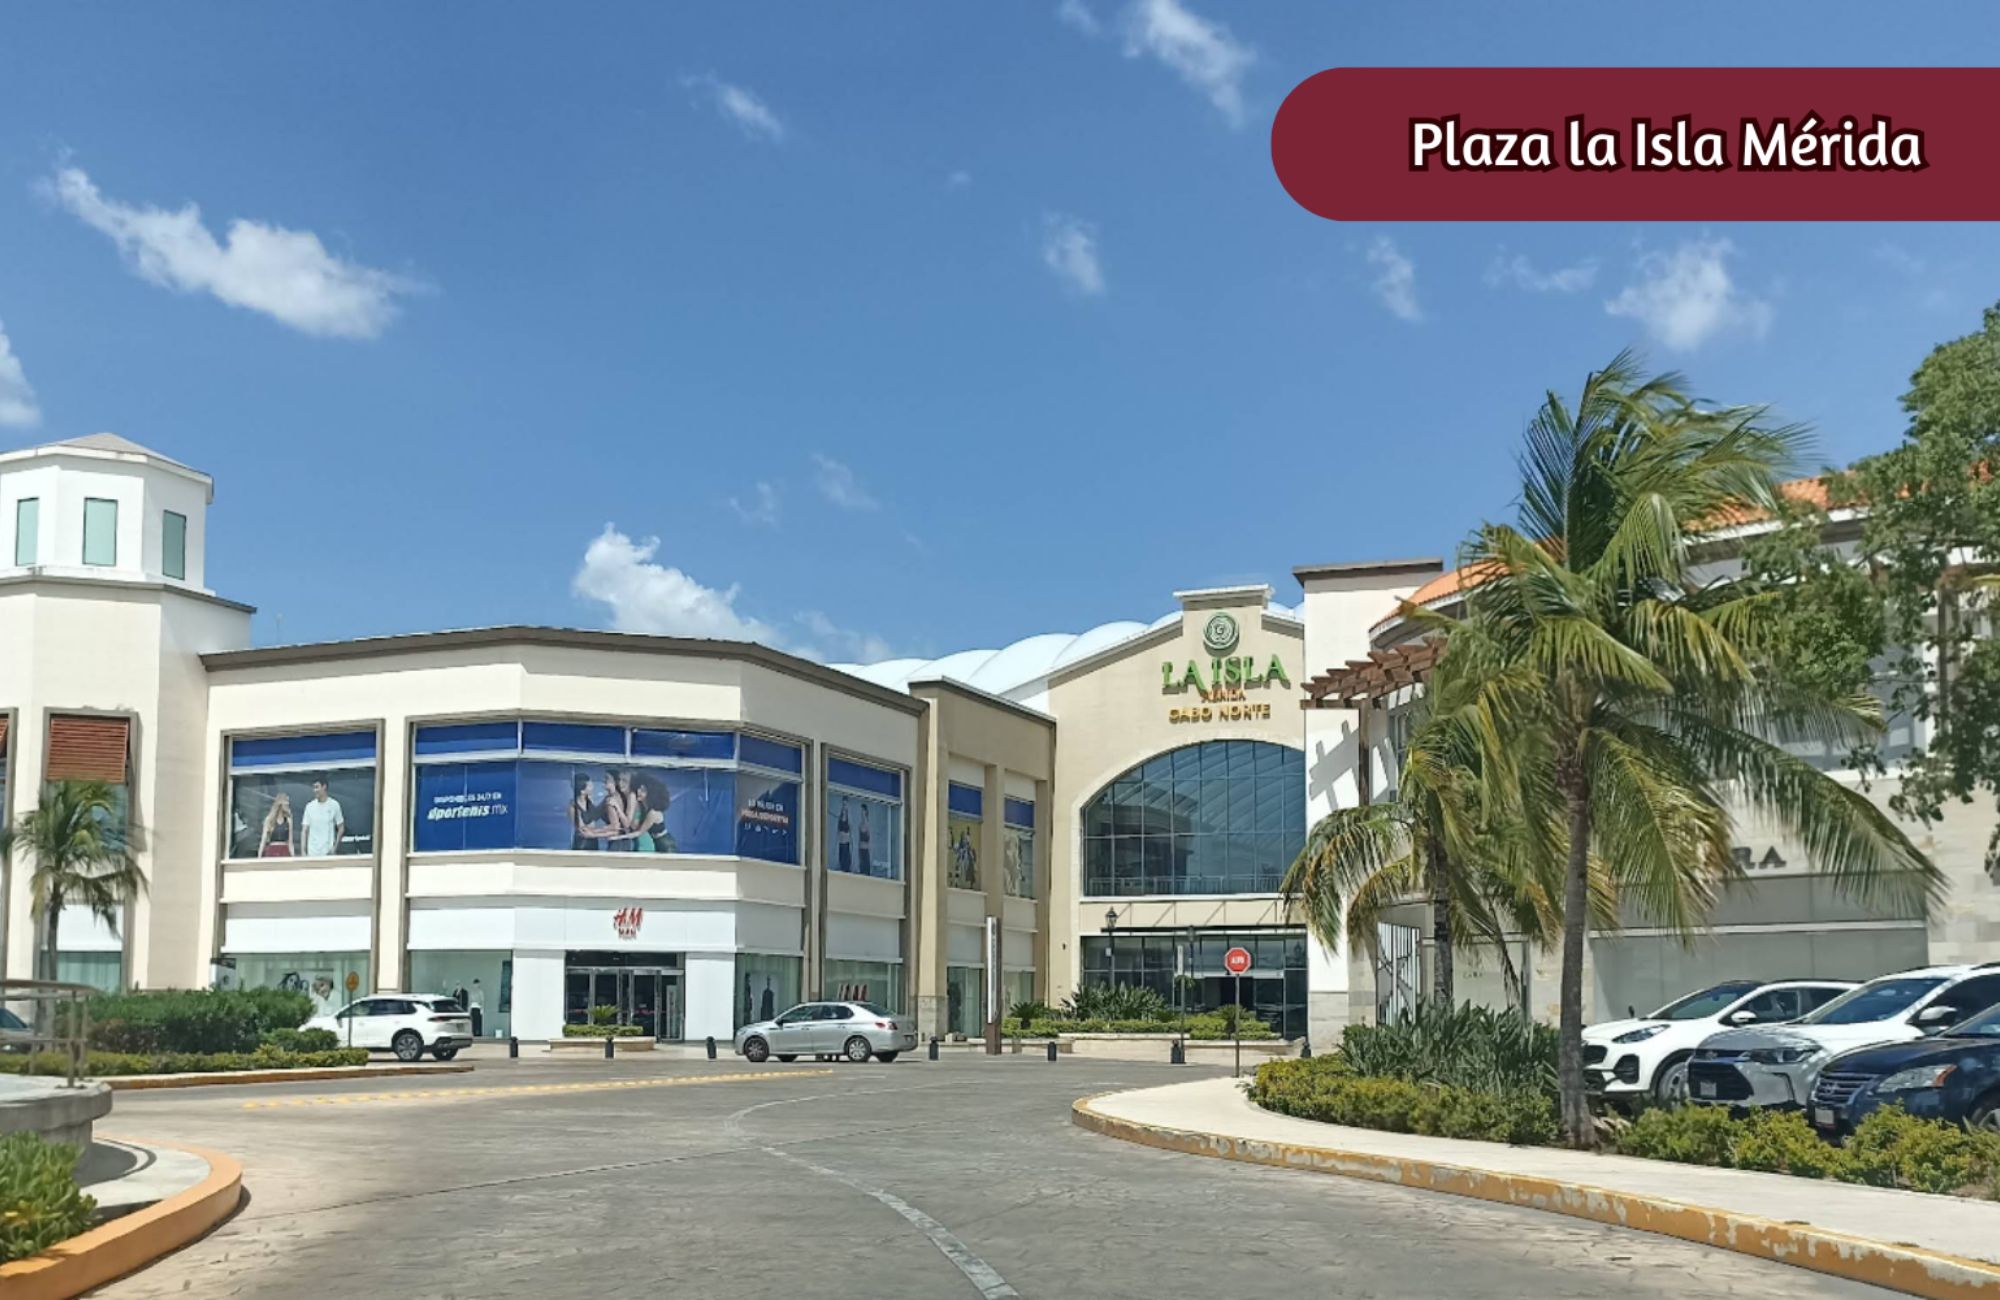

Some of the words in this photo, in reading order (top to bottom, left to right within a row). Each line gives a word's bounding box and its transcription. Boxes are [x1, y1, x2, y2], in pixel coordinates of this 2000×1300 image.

[1162, 659, 1207, 695] LA
[1211, 654, 1290, 690] ISLA
[1169, 706, 1212, 723] CABO
[1219, 703, 1271, 721] NORTE
[1731, 845, 1787, 870] RA
